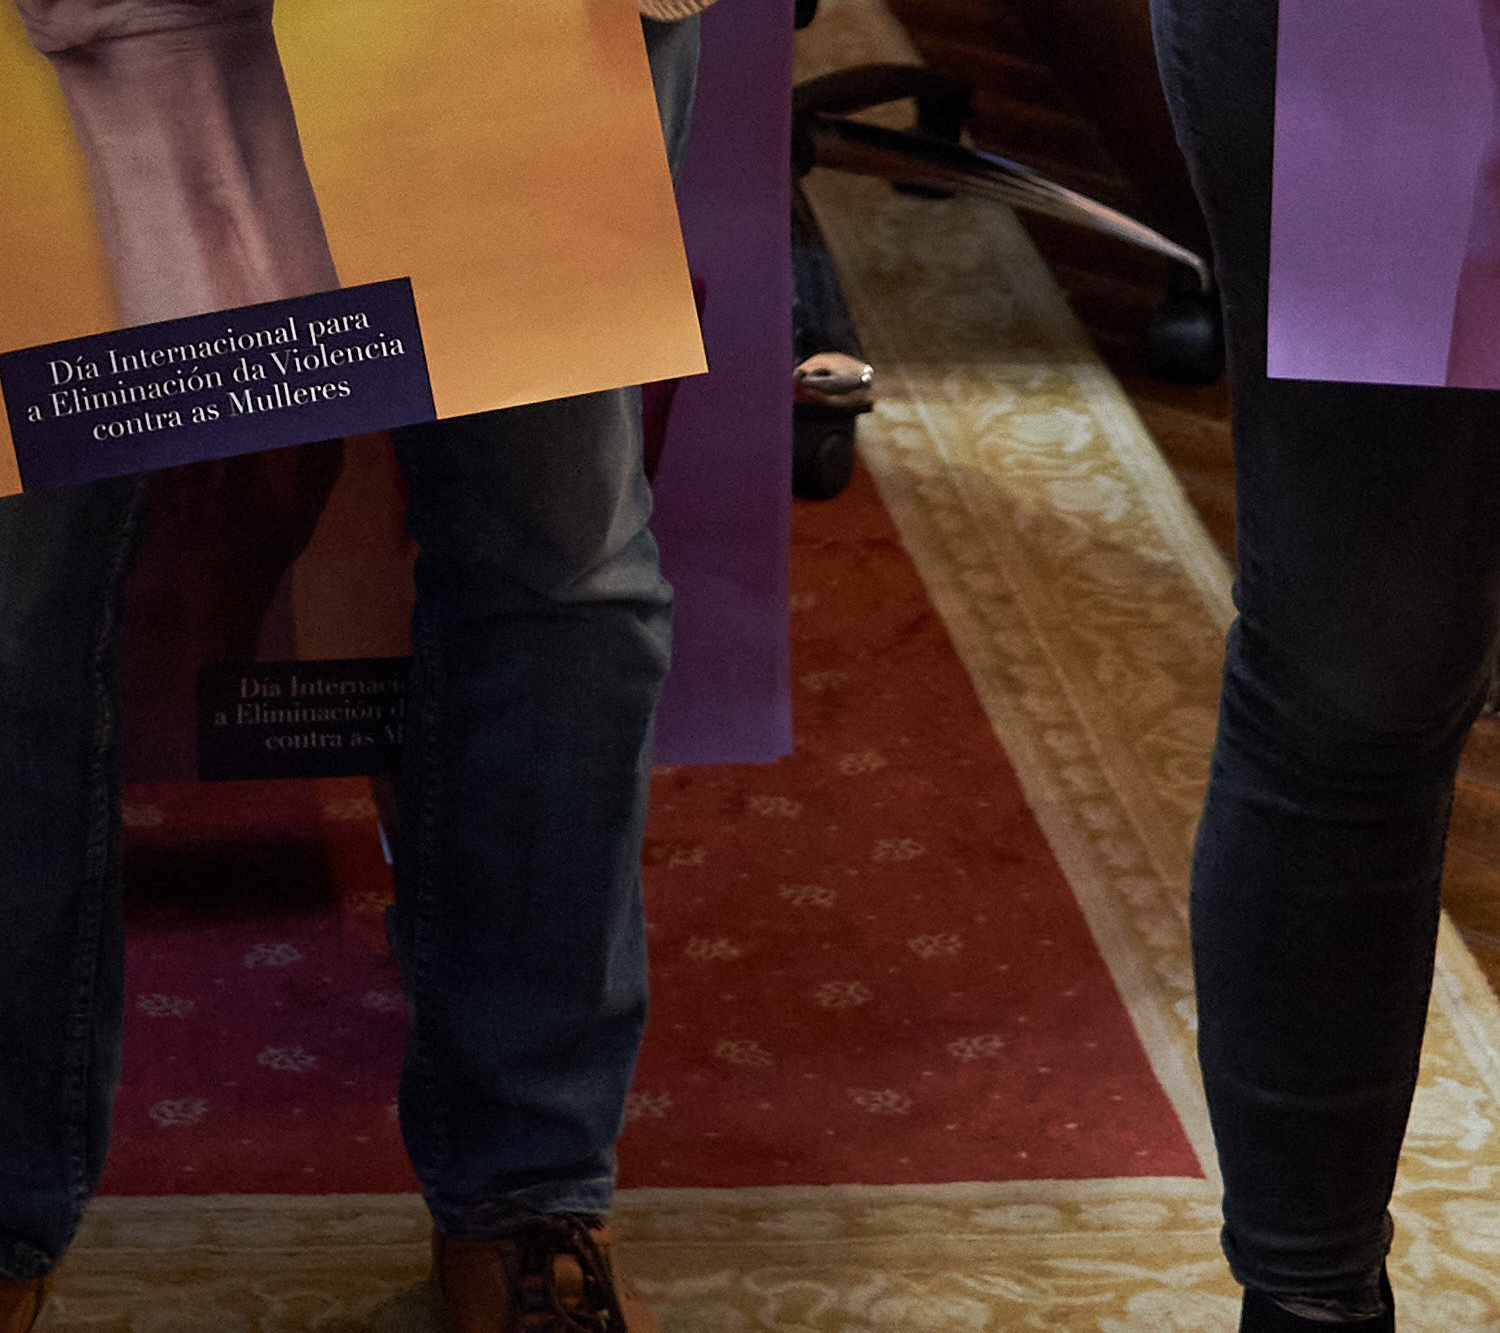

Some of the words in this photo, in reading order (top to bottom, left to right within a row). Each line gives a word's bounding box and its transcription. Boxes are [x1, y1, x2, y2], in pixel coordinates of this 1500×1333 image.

[27, 405, 42, 422] a
[51, 365, 222, 417] Eliminación
[232, 357, 266, 383] da
[271, 332, 405, 376] Violencia
[49, 355, 99, 385] Día
[108, 316, 297, 374] Internacional
[308, 312, 369, 347] para
[92, 410, 182, 440] contra
[191, 403, 220, 423] as
[228, 380, 351, 413] Mulleres
